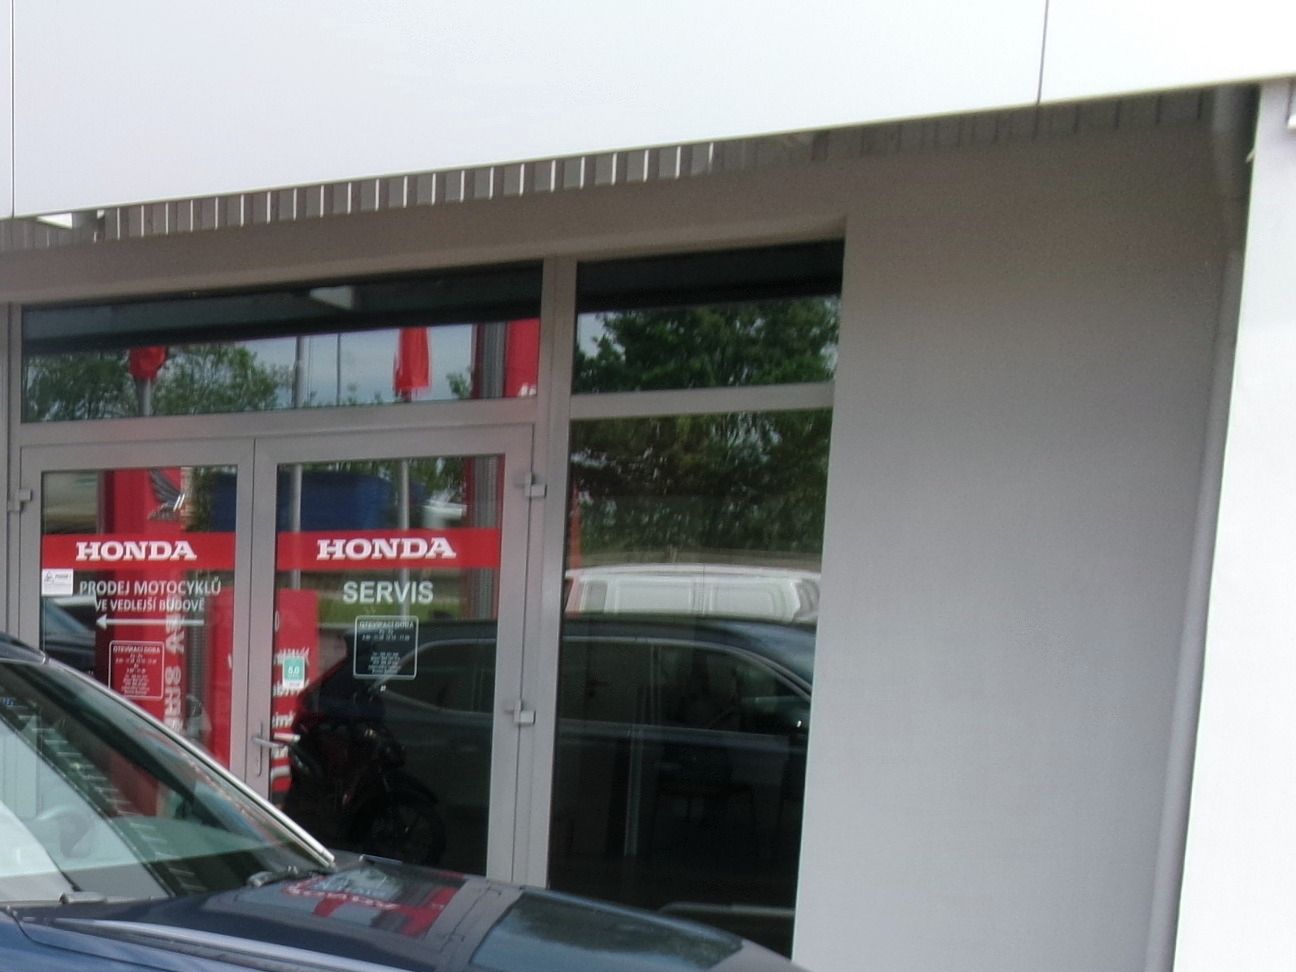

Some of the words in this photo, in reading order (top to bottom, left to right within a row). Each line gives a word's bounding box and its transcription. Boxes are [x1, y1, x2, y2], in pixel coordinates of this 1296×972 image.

[75, 540, 197, 561] HONDA
[316, 537, 456, 560] HONDA
[79, 579, 131, 597] PRODEJ
[133, 576, 222, 597] MOTOCYKLŮ
[343, 580, 434, 605] SERVIS
[95, 598, 108, 612] VE
